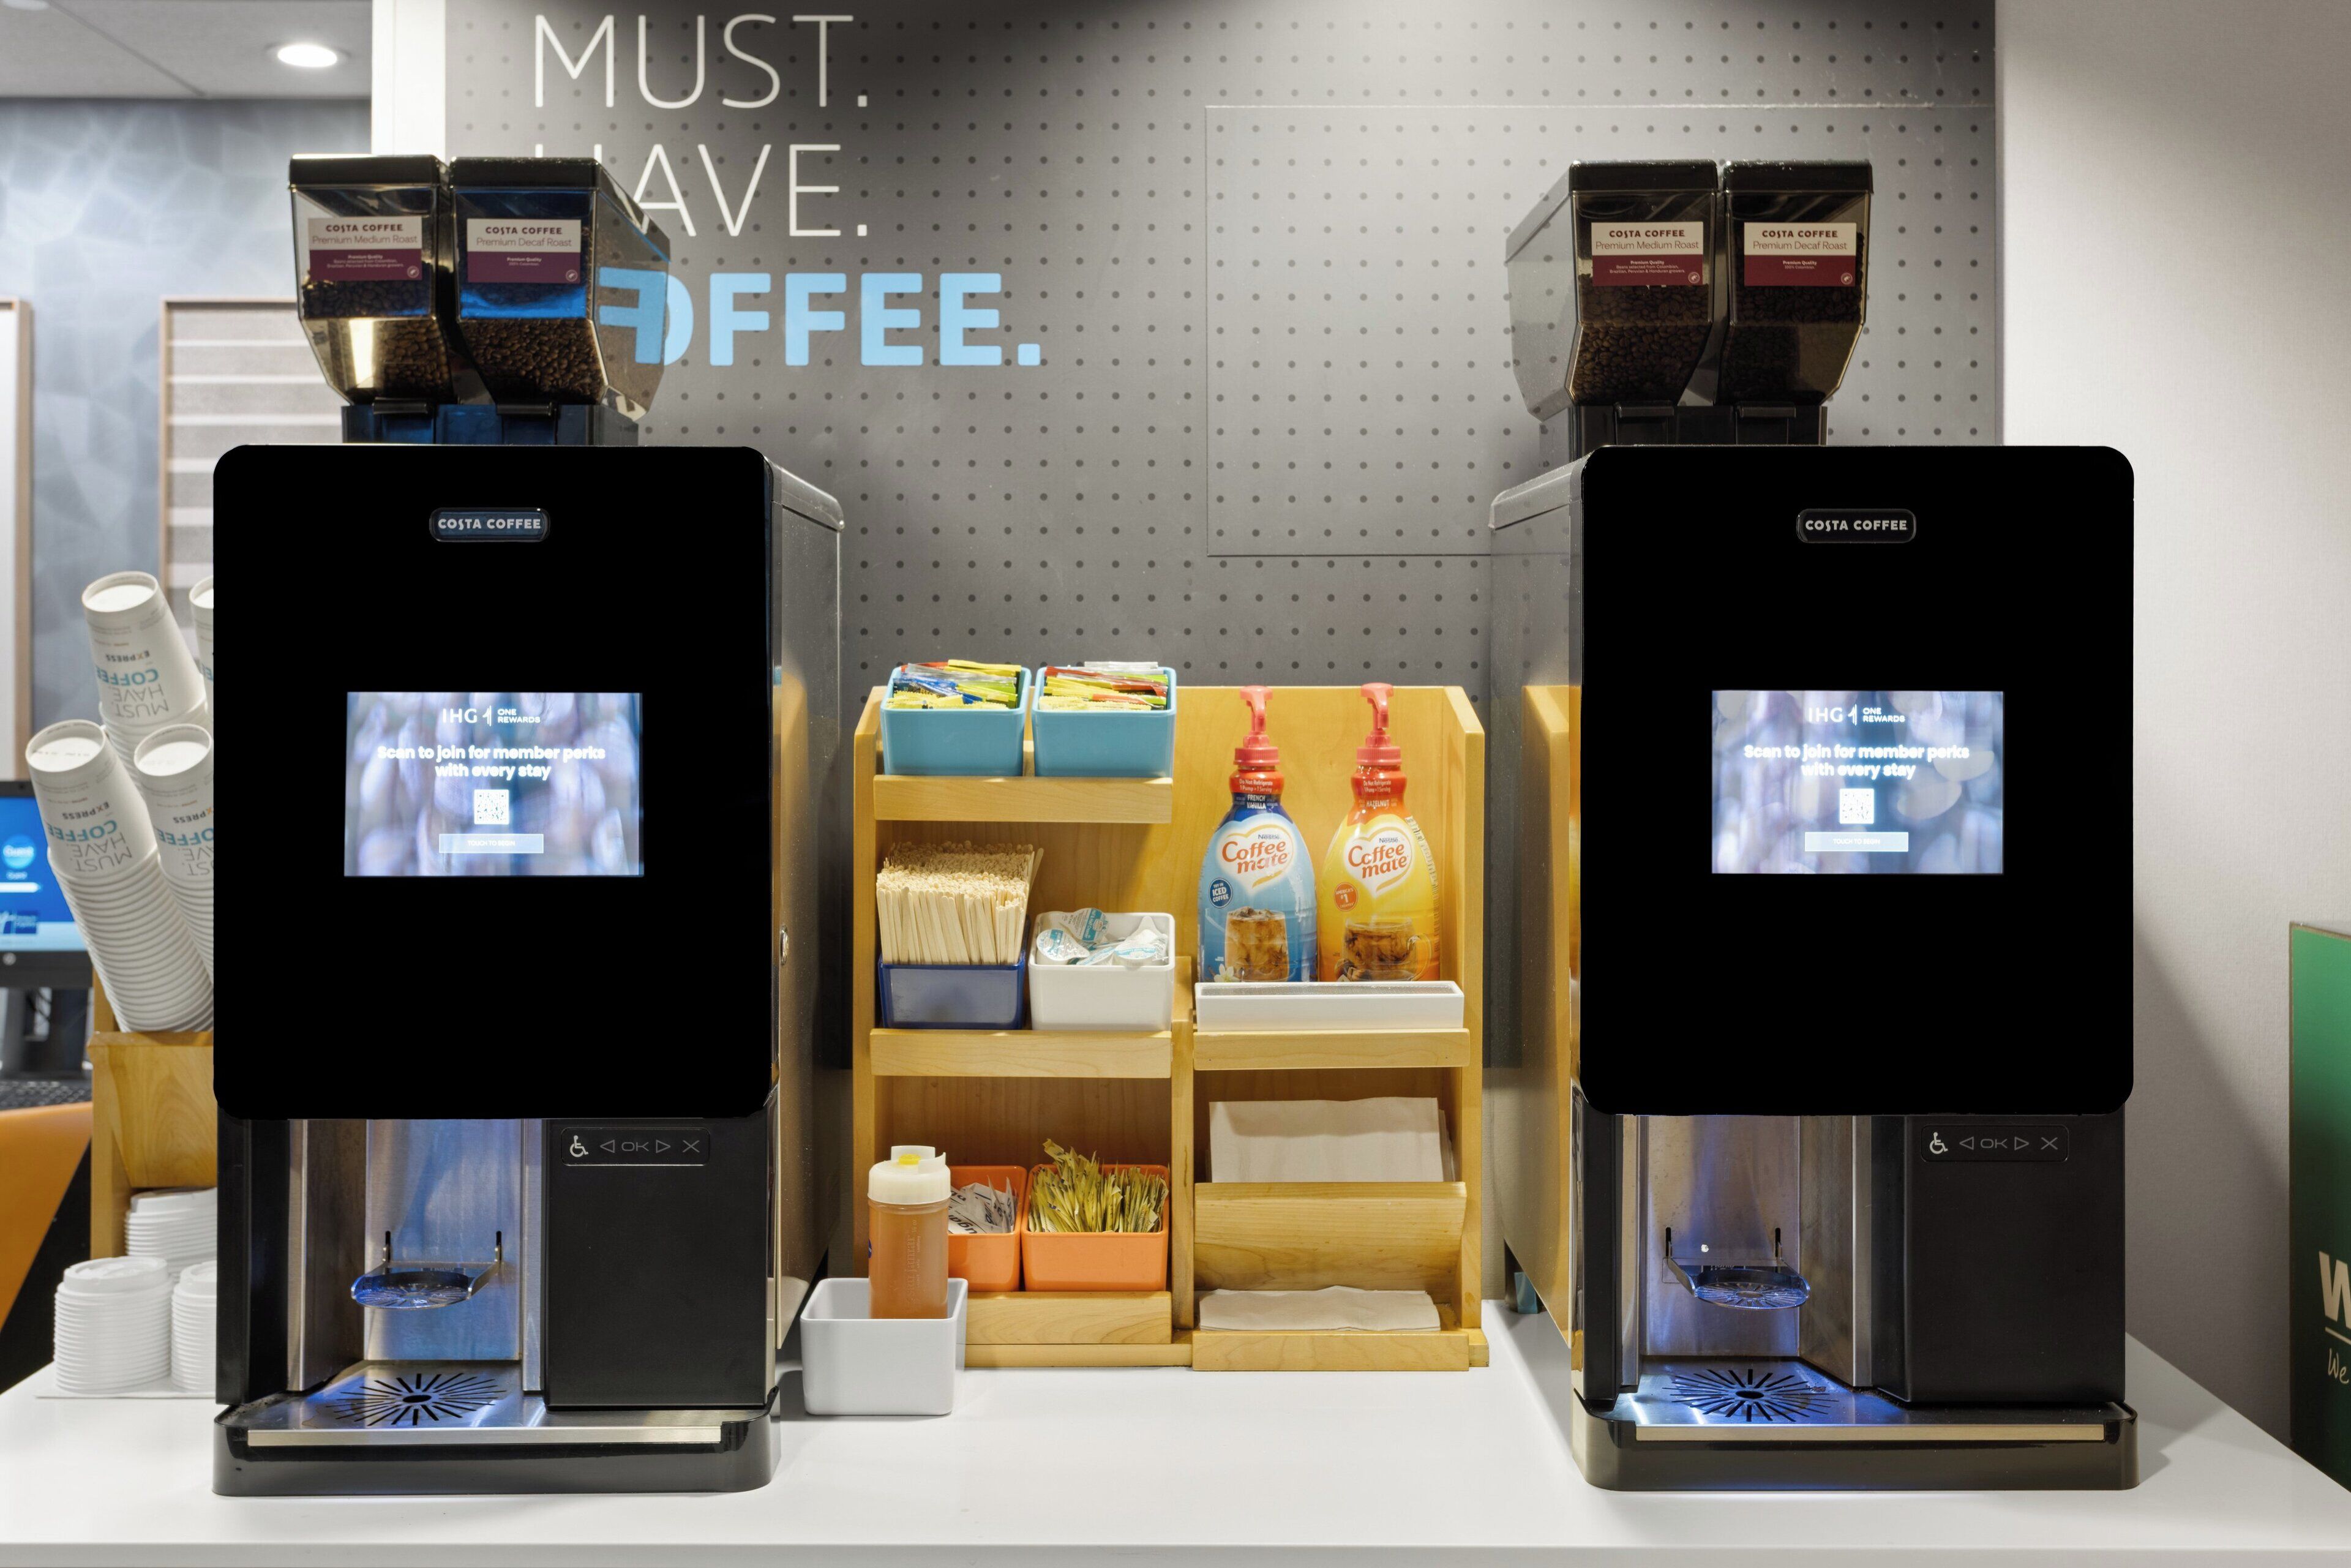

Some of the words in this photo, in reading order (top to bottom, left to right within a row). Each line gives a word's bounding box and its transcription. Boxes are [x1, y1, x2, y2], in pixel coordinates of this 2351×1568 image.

[535, 14, 868, 109] MUST.
[535, 144, 868, 237] AVE.
[326, 224, 358, 233] COSTA
[312, 235, 352, 244] Premium
[354, 235, 391, 244] Medium
[392, 234, 418, 243] Roast
[476, 237, 516, 246] Premium
[519, 238, 545, 246] Decaf
[1595, 241, 1635, 250] Premium
[1637, 240, 1672, 249] Medium
[1674, 240, 1699, 249] Roast
[1753, 241, 1792, 249] Premium
[1794, 241, 1821, 250] Decaf
[1823, 241, 1847, 250] Roast
[438, 519, 481, 530] COSTA
[487, 519, 541, 529] COFFEE
[1805, 520, 1848, 531] COSTA
[1853, 520, 1907, 530] COFFEE
[105, 650, 150, 662] EXPRESS
[443, 708, 478, 724] IHG
[1808, 707, 1843, 722] IHG
[377, 746, 416, 759] Scan
[418, 746, 435, 759] to
[436, 745, 466, 762] join
[468, 745, 491, 759] for
[493, 745, 560, 759] member
[563, 746, 606, 762] perks
[1744, 745, 1782, 759] Scan
[1784, 745, 1801, 759] to
[1802, 744, 1832, 762] join
[1834, 744, 1856, 759] for
[1858, 745, 1924, 759] member
[1927, 745, 1970, 762] perks
[435, 763, 469, 778] with
[471, 765, 516, 781] every
[518, 763, 552, 781] stay
[1801, 762, 1835, 777] with
[1837, 765, 1880, 780] every
[1883, 763, 1916, 780] stay
[62, 801, 110, 820] EXPRESS
[66, 832, 126, 858] HAVE.
[1222, 841, 1286, 862] Coffee
[70, 846, 132, 872] MUST.
[1237, 853, 1289, 874] mate
[1348, 844, 1404, 867] Coffee
[1362, 856, 1408, 879] mate
[1212, 887, 1227, 897] ICED
[1213, 894, 1229, 902] COFFEE
[621, 1141, 650, 1152] OK
[1980, 1138, 2008, 1149] OK
[2328, 1348, 2350, 1384] We
